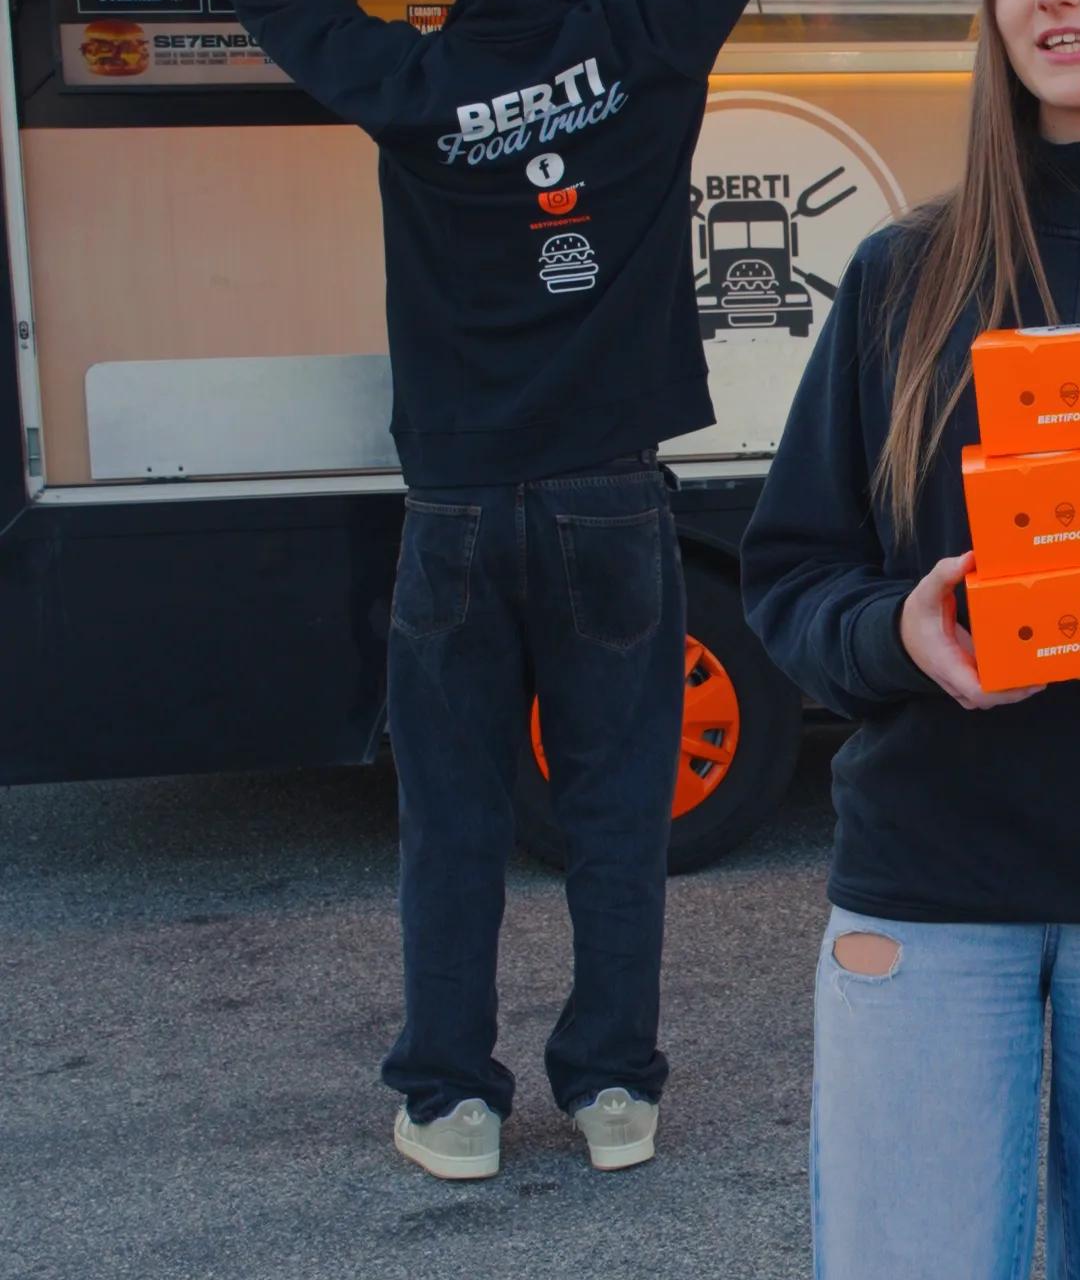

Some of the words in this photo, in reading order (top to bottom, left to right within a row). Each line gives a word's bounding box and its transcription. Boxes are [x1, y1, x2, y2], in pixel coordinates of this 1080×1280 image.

[153, 34, 260, 48] SE7ENBU
[437, 111, 531, 165] Food
[535, 81, 629, 143] truck
[456, 57, 606, 142] BERTI
[706, 174, 790, 200] BERTI
